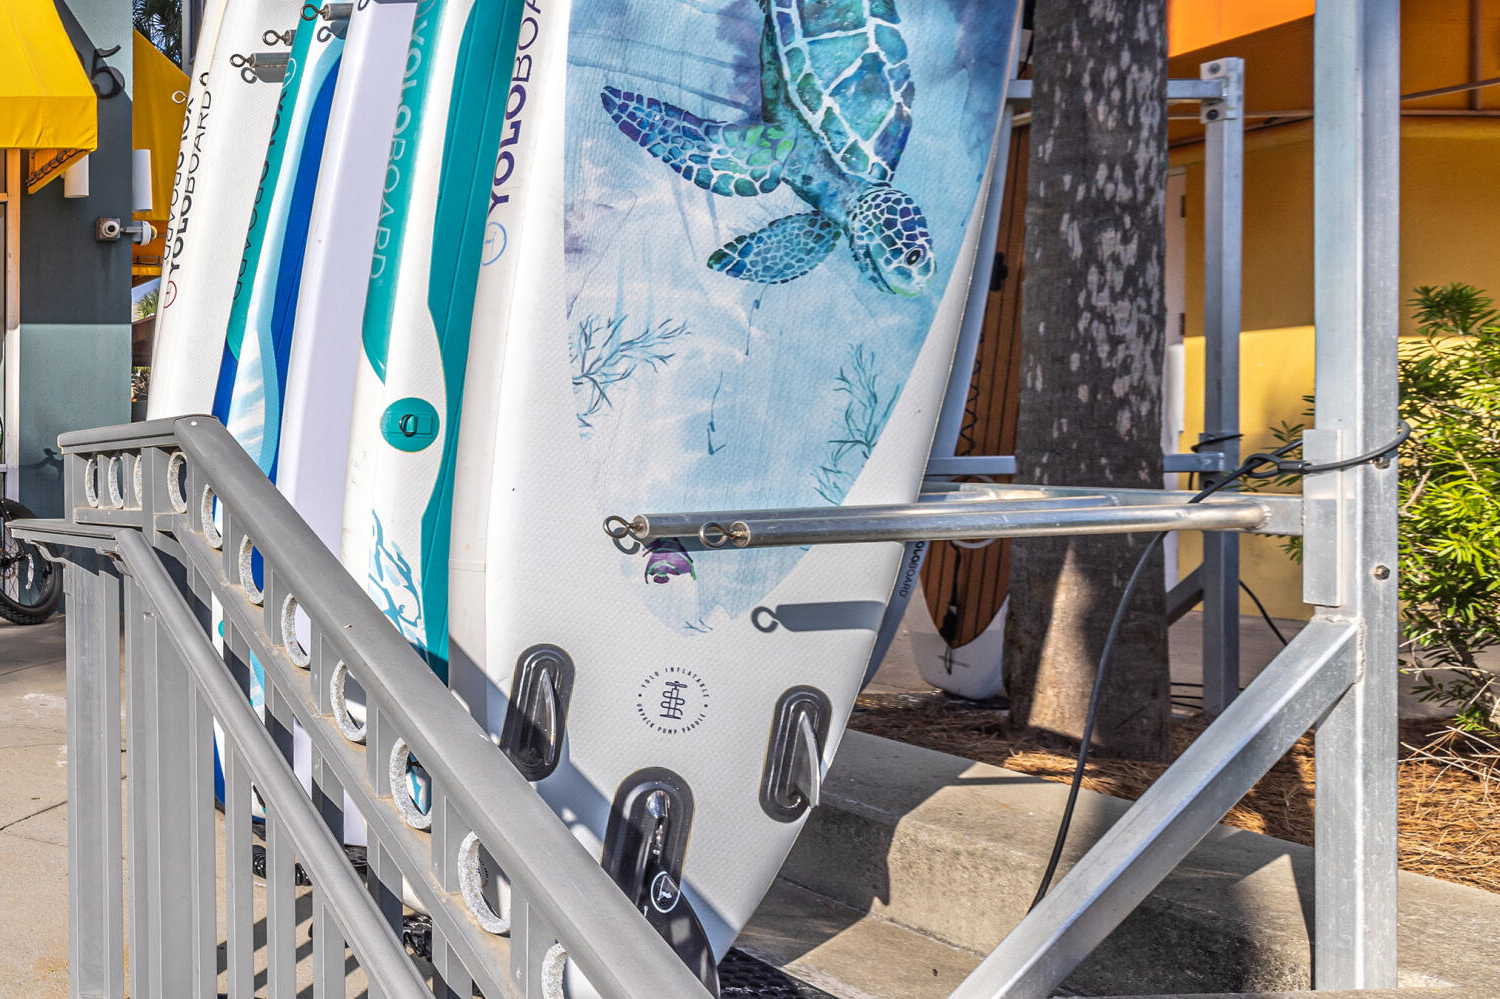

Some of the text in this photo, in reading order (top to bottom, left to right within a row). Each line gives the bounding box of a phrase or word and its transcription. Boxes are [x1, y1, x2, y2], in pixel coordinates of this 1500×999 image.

[899, 541, 925, 598] OLOBOARD
[641, 667, 709, 698] YOLO INFLATABLE
[637, 703, 706, 735] UNPACK PUMP PADDLE
